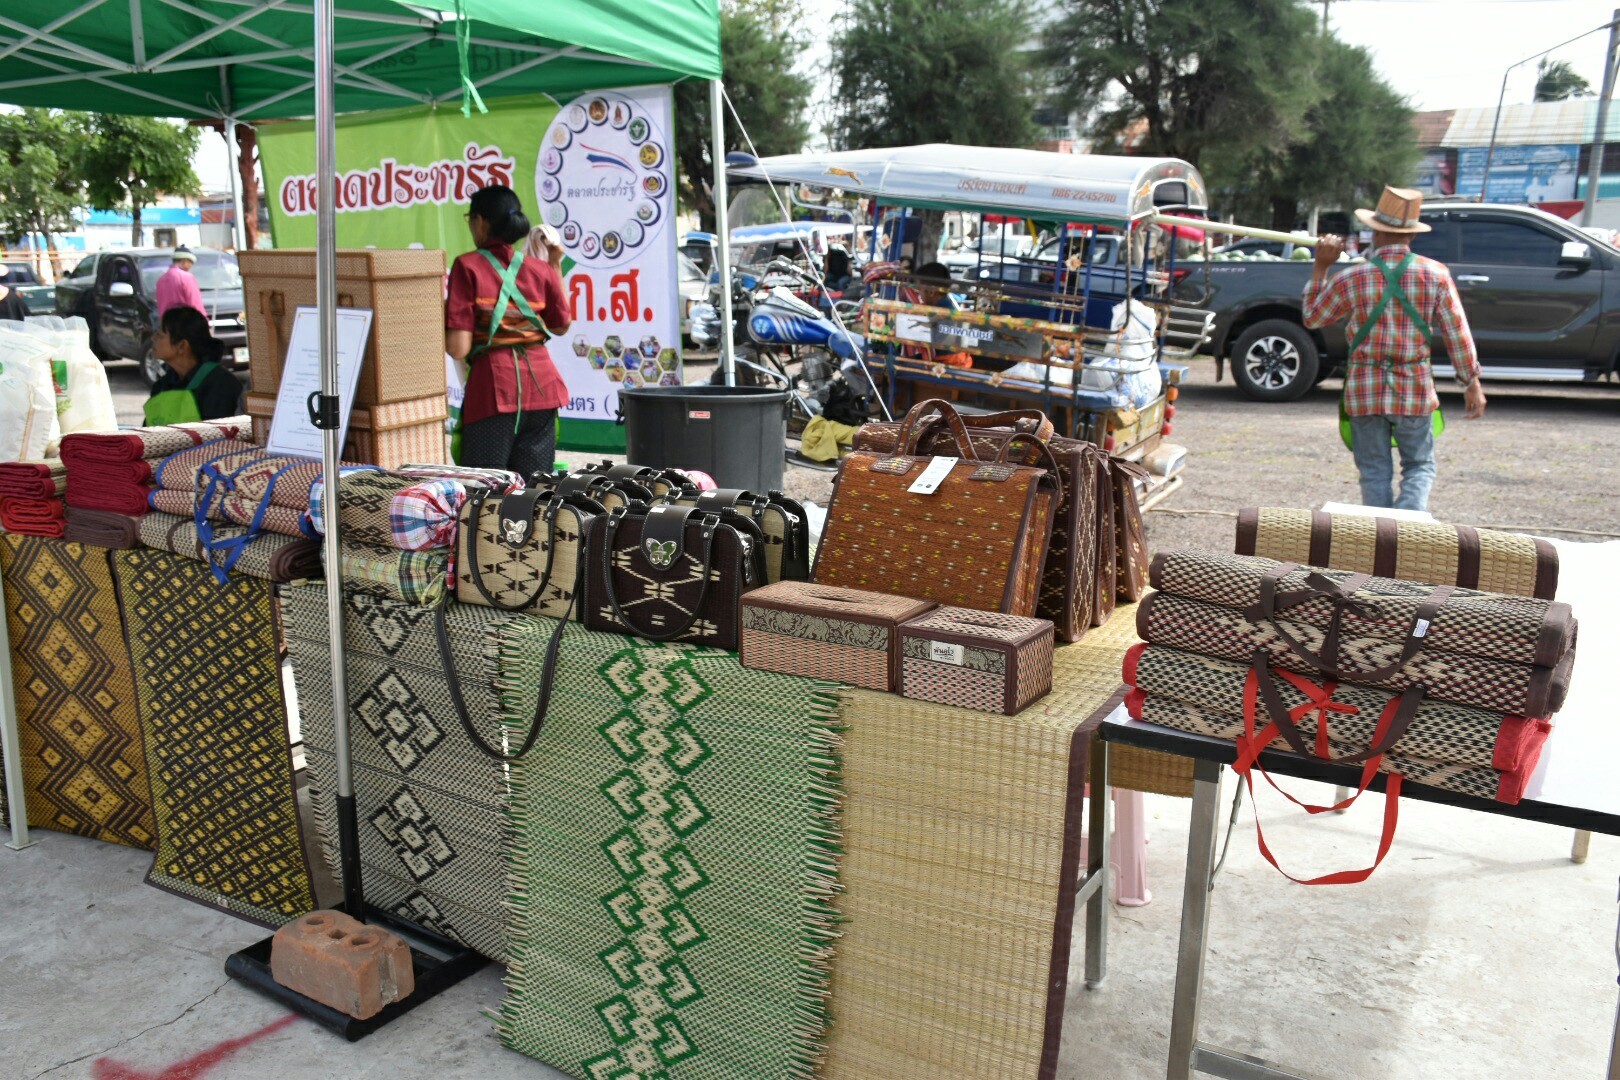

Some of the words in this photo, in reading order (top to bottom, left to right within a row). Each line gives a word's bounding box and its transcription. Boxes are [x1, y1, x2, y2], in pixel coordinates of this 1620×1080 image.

[567, 176, 637, 201] ตลาดประชารัฐ
